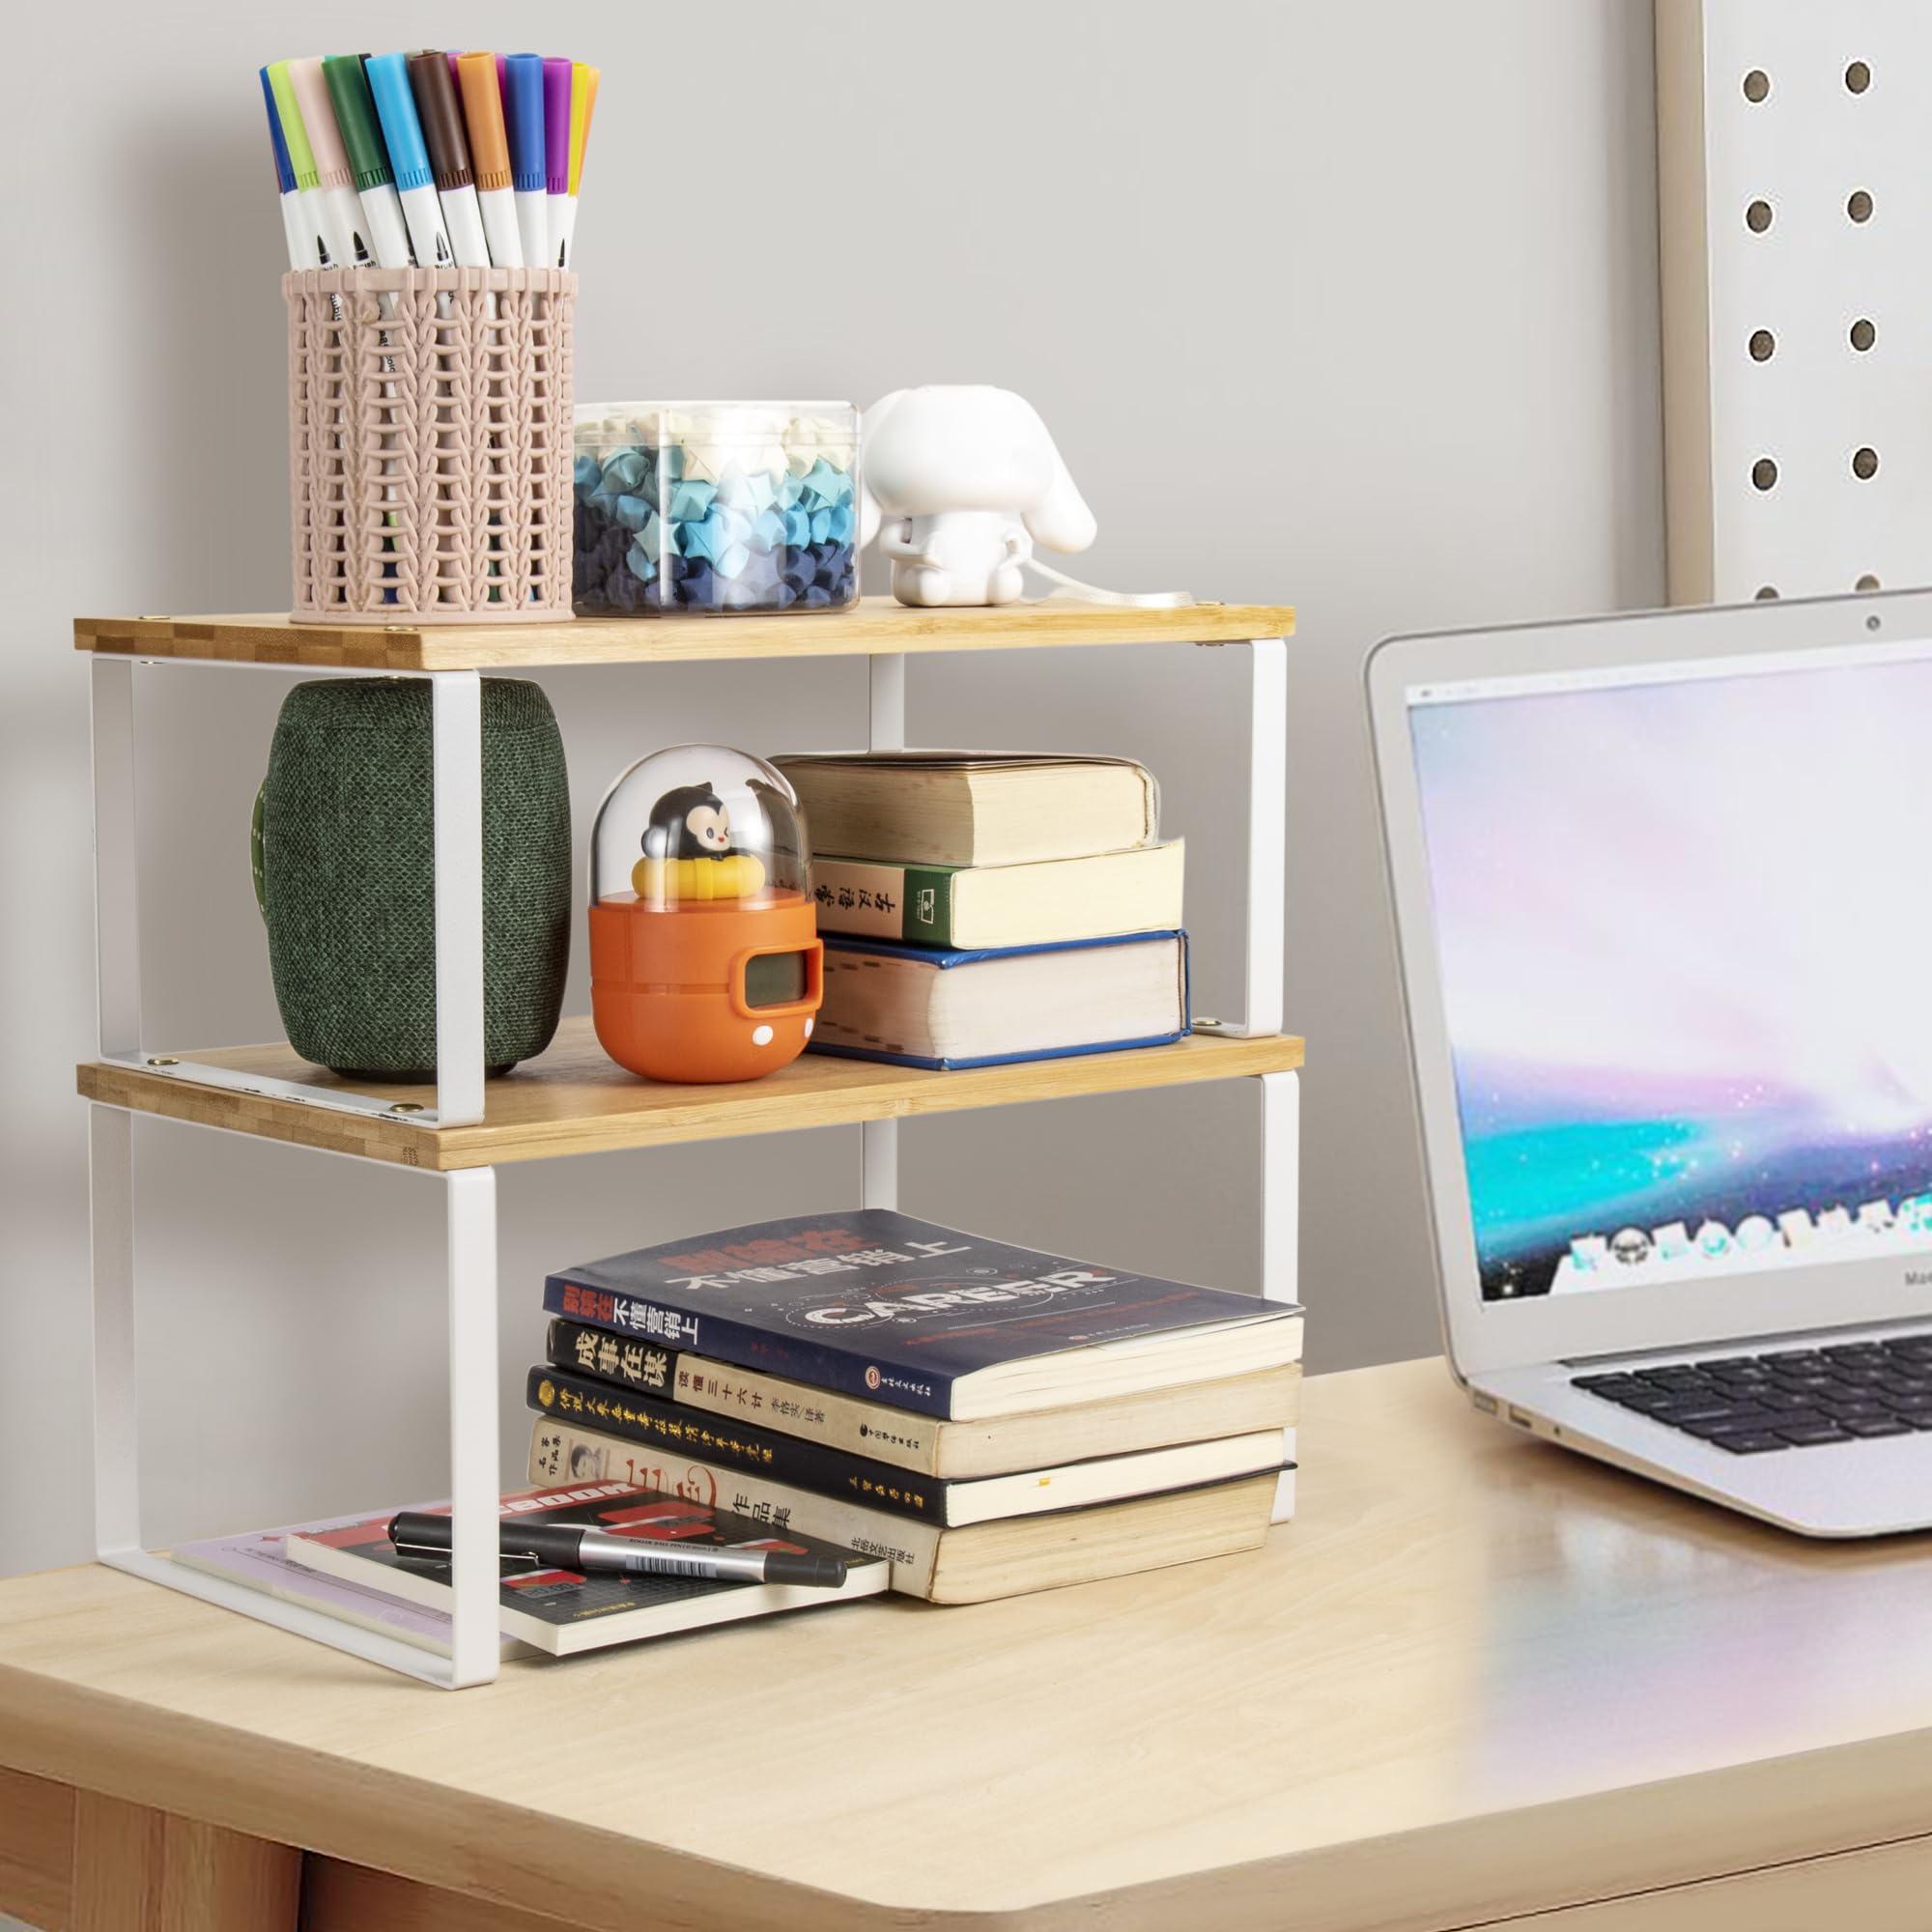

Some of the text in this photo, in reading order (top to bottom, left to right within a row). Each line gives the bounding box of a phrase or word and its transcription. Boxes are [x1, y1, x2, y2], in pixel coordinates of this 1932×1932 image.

[664, 1240, 973, 1290] 不懂营销上
[804, 1269, 1118, 1324] CAREER
[576, 1332, 668, 1387] 成事在谋
[678, 1371, 763, 1409] 读懂三十六计
[851, 1537, 915, 1565] 北岳文艺出版社
